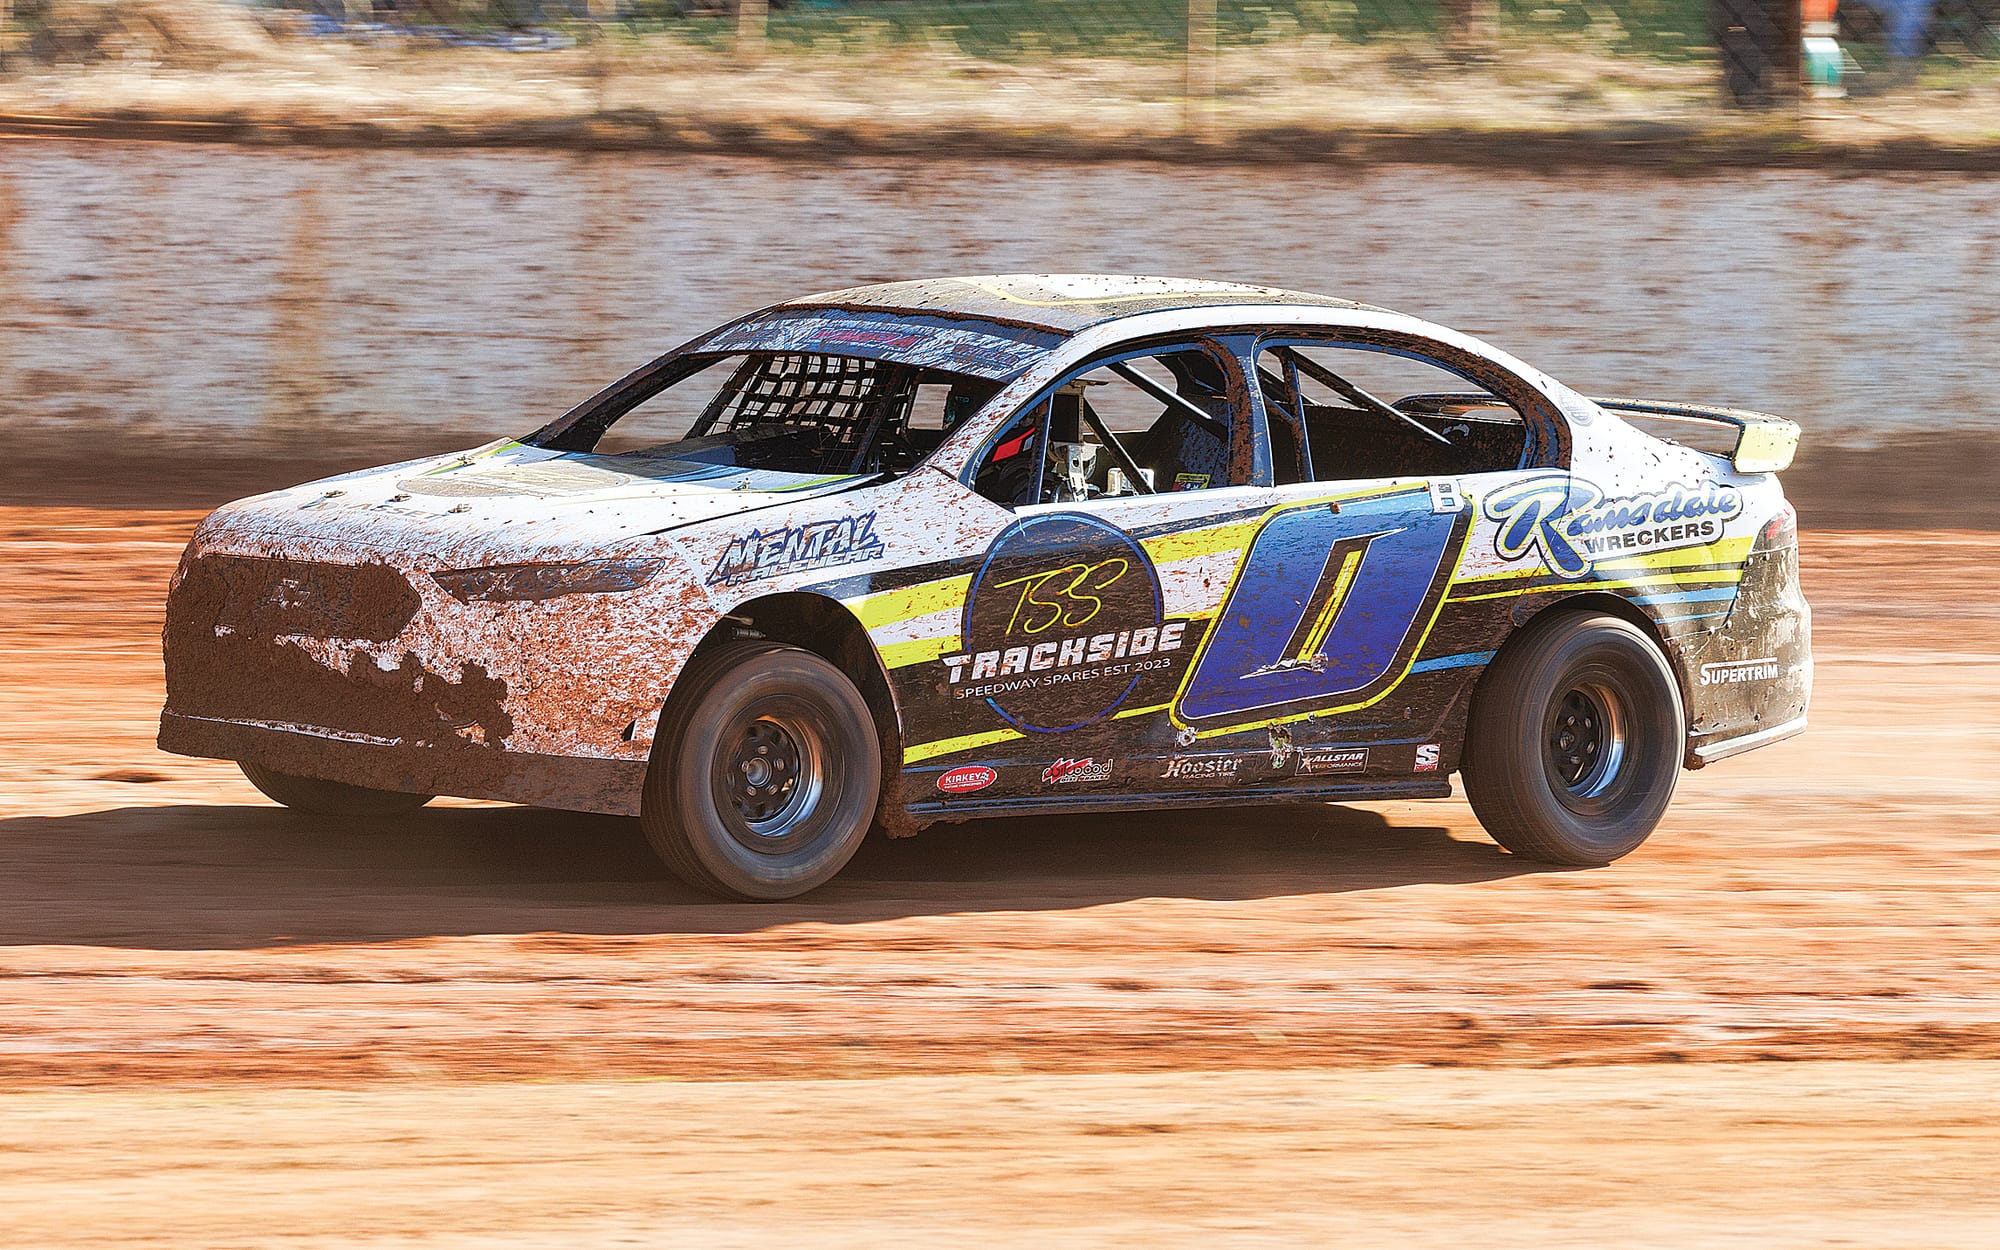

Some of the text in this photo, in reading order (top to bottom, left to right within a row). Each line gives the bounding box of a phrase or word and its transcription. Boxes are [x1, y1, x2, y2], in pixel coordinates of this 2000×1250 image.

[1486, 477, 1740, 577] Ramsdale
[1585, 521, 1715, 554] WRECKERS
[704, 510, 880, 586] MENTAL
[941, 622, 1187, 685] TRACKSIDE
[956, 657, 1171, 700] SPEEDWAY SPARES EST 2023
[1700, 657, 1778, 686] SUPERTRIM
[1160, 756, 1243, 778] Hoosier
[1311, 752, 1365, 763] ALLSTAR
[1311, 762, 1364, 770] PERFORMANCE
[945, 771, 981, 784] KIRKEY
[1182, 771, 1216, 780] RACING
